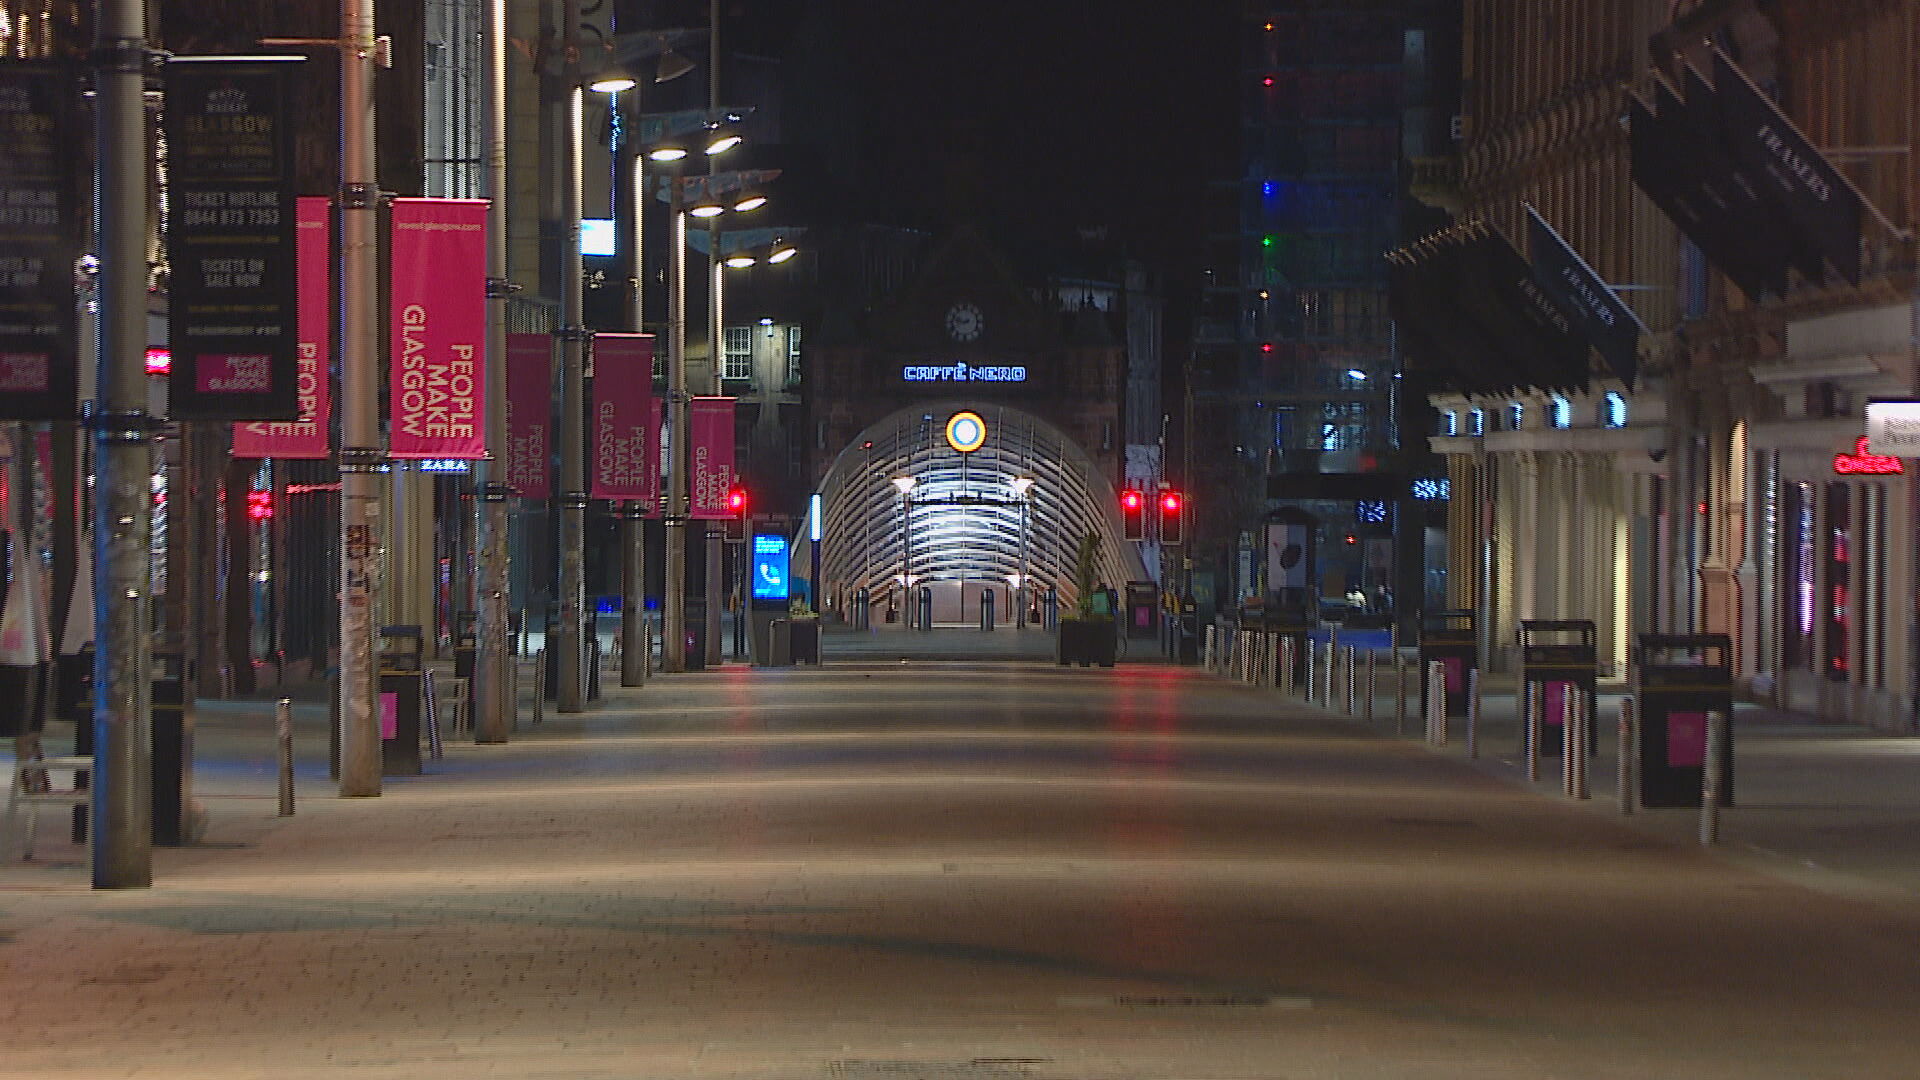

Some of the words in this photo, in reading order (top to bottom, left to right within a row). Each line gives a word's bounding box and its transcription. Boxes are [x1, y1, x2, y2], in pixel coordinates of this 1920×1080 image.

[1757, 125, 1830, 201] FRASERS
[184, 191, 225, 206] TICKET
[228, 191, 280, 206] HOTLINE
[184, 209, 218, 226] 0844
[220, 209, 245, 226] 873
[248, 209, 280, 226] 7353
[202, 258, 246, 273] TICKETS
[248, 258, 265, 273] ON
[205, 273, 233, 288] SALE
[234, 273, 262, 288] NOW
[401, 304, 426, 438] GLASGOW
[450, 344, 474, 438] PEOPLE
[969, 366, 1026, 382] NERO
[426, 363, 450, 438] MAKE
[420, 459, 469, 472] ZARA
[513, 437, 528, 484] MAKE
[528, 425, 543, 485] PEOPLE
[600, 401, 614, 486] GLASGOW
[614, 438, 629, 487] MAKE
[630, 427, 645, 487] PEOPLE
[1833, 454, 1905, 475] OMEGA
[696, 447, 707, 510] GLASGOW
